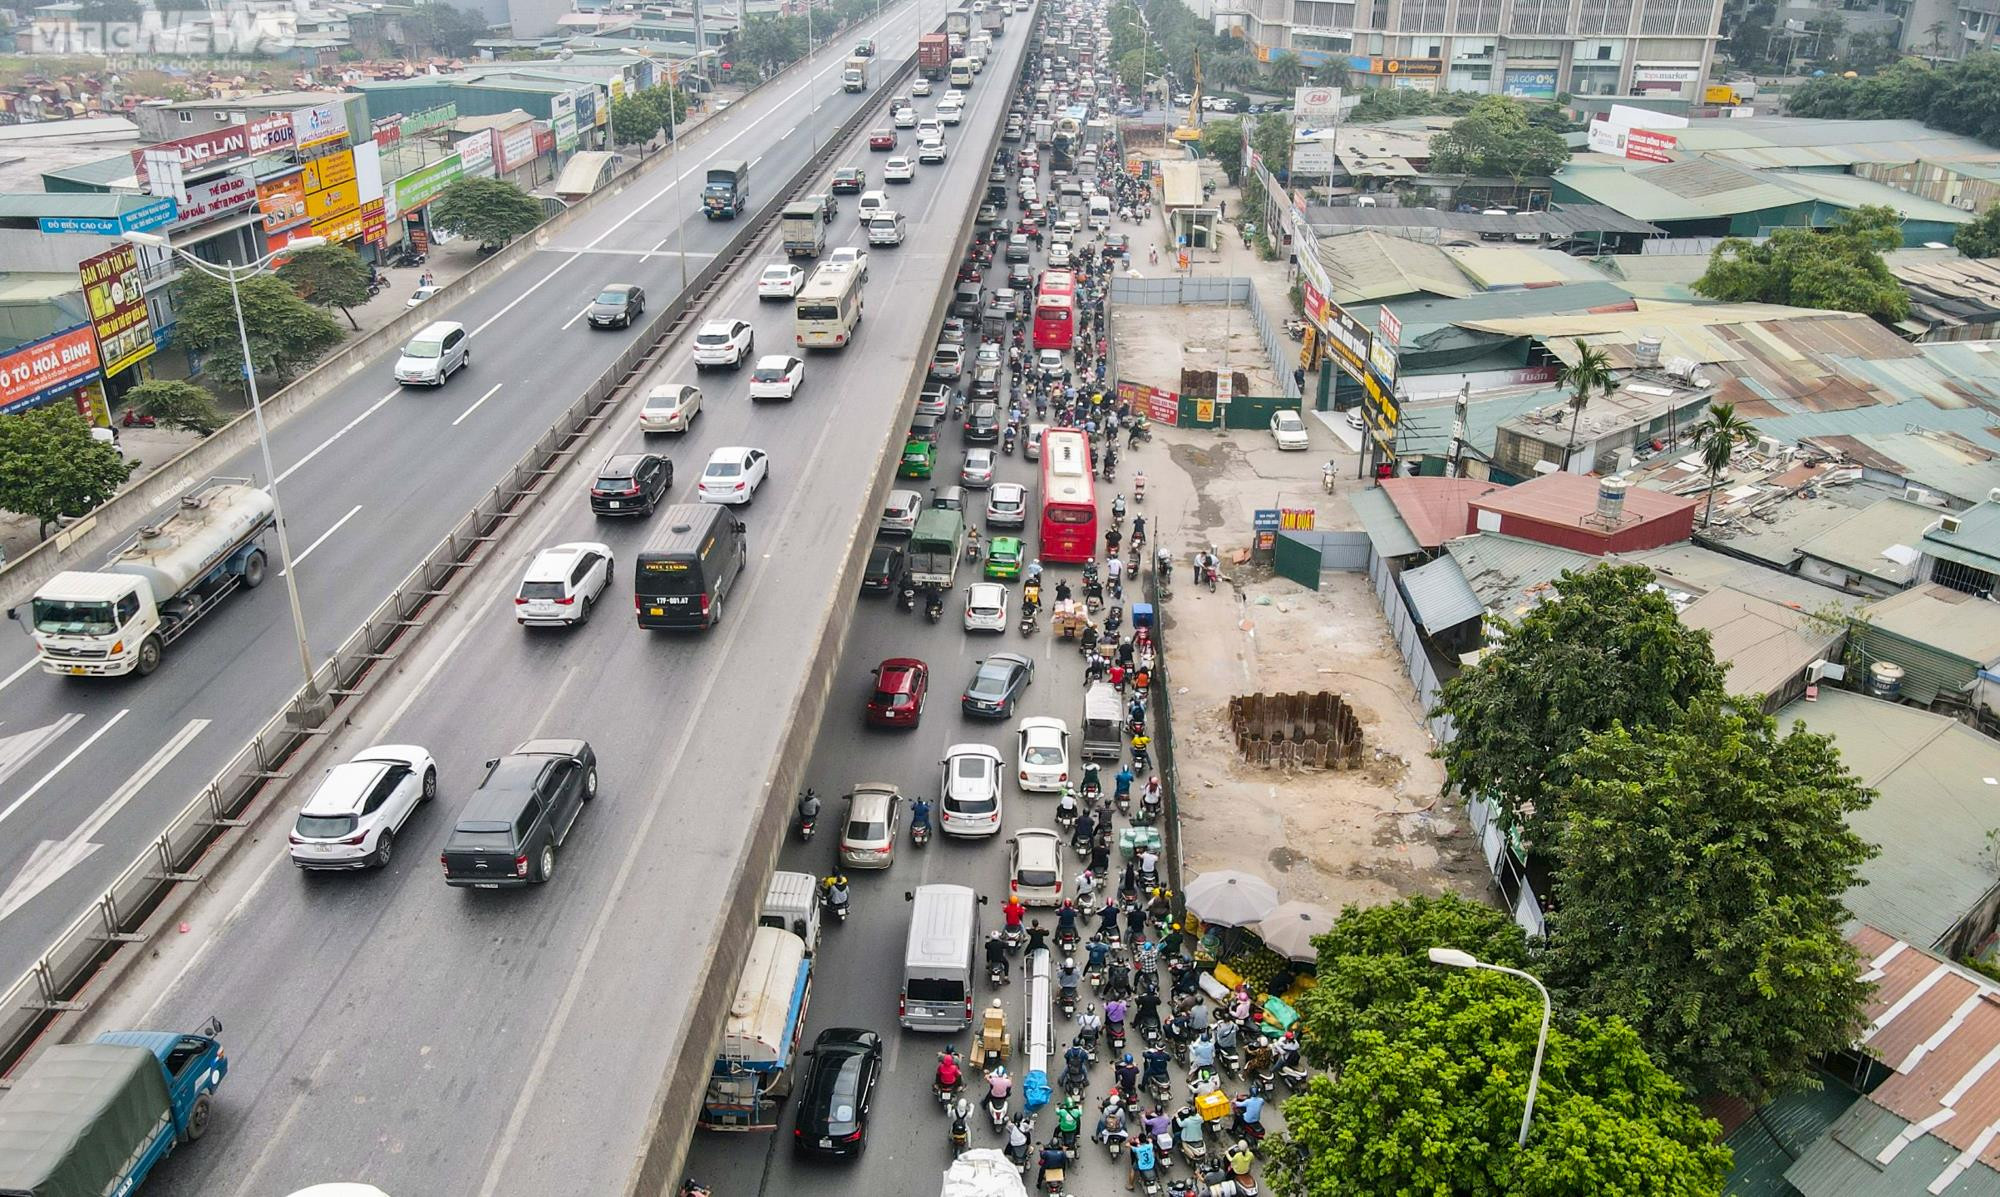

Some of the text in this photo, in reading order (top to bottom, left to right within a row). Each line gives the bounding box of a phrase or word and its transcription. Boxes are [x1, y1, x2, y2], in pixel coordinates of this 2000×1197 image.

[211, 134, 243, 155] LAN
[80, 222, 96, 230] CAO
[11, 362, 31, 383] TÔ
[32, 352, 60, 375] HOÀ
[62, 341, 90, 364] BÌNH
